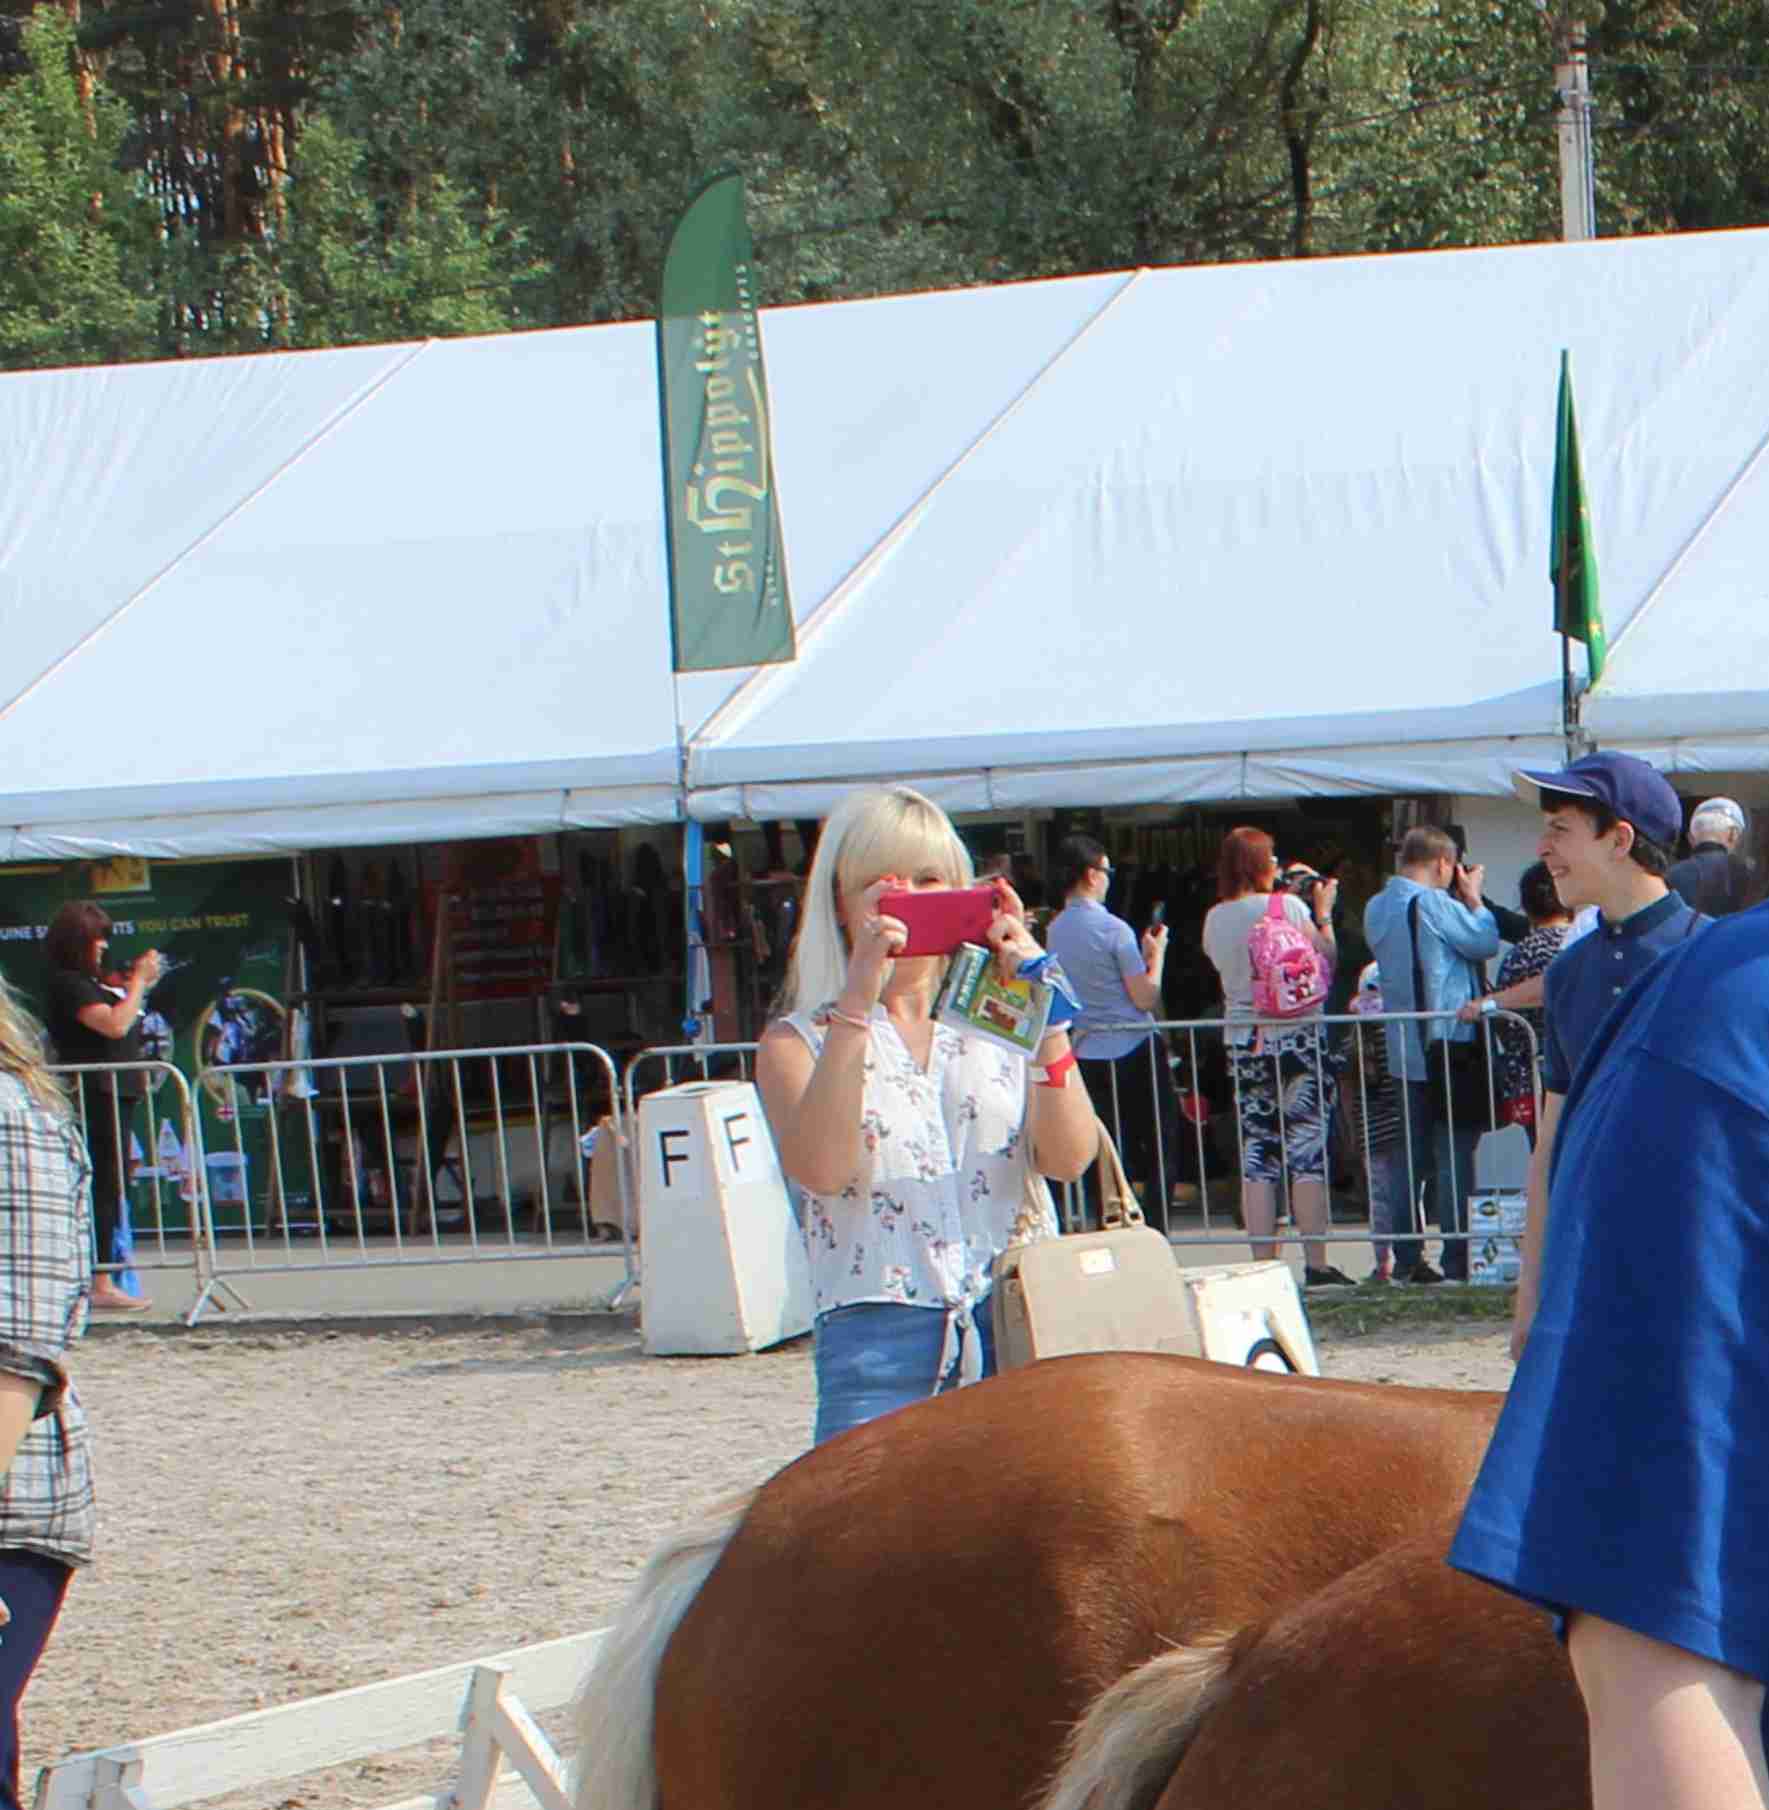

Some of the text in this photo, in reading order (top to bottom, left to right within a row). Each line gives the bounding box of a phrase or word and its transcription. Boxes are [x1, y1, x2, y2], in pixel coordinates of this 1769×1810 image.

[713, 541, 756, 593] St
[206, 912, 248, 928] TRUST
[660, 1129, 690, 1188] F
[723, 1112, 750, 1173] F
